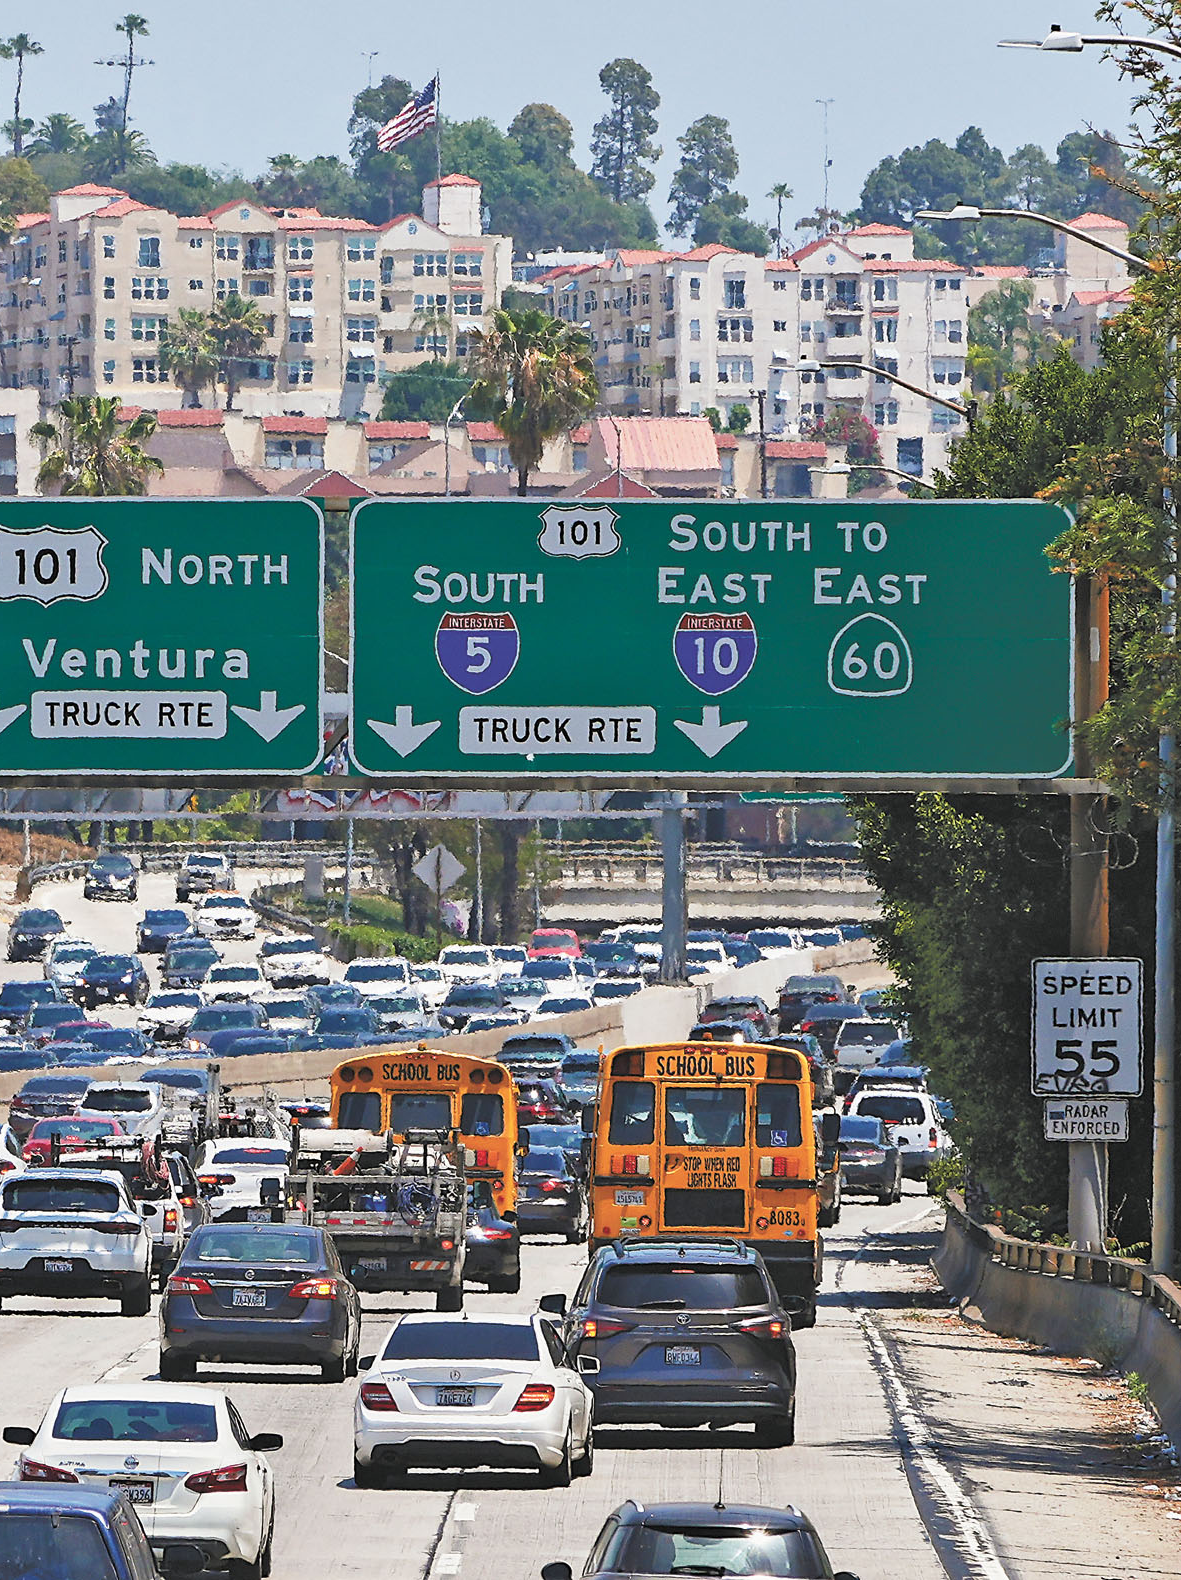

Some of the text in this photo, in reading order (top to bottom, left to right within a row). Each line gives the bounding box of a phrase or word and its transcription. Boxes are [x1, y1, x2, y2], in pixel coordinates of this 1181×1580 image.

[557, 520, 603, 547] 101
[669, 514, 889, 553] SOUTH TO
[14, 548, 290, 586] 101 NORTH
[412, 565, 546, 604] SOUTH
[658, 567, 773, 605] EAST
[814, 567, 929, 605] EAST
[449, 617, 505, 628] INTERSTATE
[687, 618, 743, 629] INTERSTATE
[22, 638, 250, 680] Ventura
[466, 636, 492, 673] 5
[694, 637, 739, 675] 10
[842, 639, 901, 680] 60
[45, 702, 214, 729] TRUCK RTE
[473, 717, 644, 744] TRUCK RTE
[1043, 976, 1132, 995] SPEED
[1052, 1007, 1122, 1027] LIMIT
[382, 1063, 460, 1081] SCHOOL BUS
[656, 1056, 755, 1076] SCHOOL BUS
[1055, 1040, 1120, 1078] 55
[1065, 1104, 1108, 1119] RADAR
[1052, 1121, 1120, 1135] ENFORCED
[683, 1156, 741, 1172] STOP WHEN RED
[687, 1172, 737, 1188] LIGHTS FLASH
[769, 1210, 799, 1227] 8083
